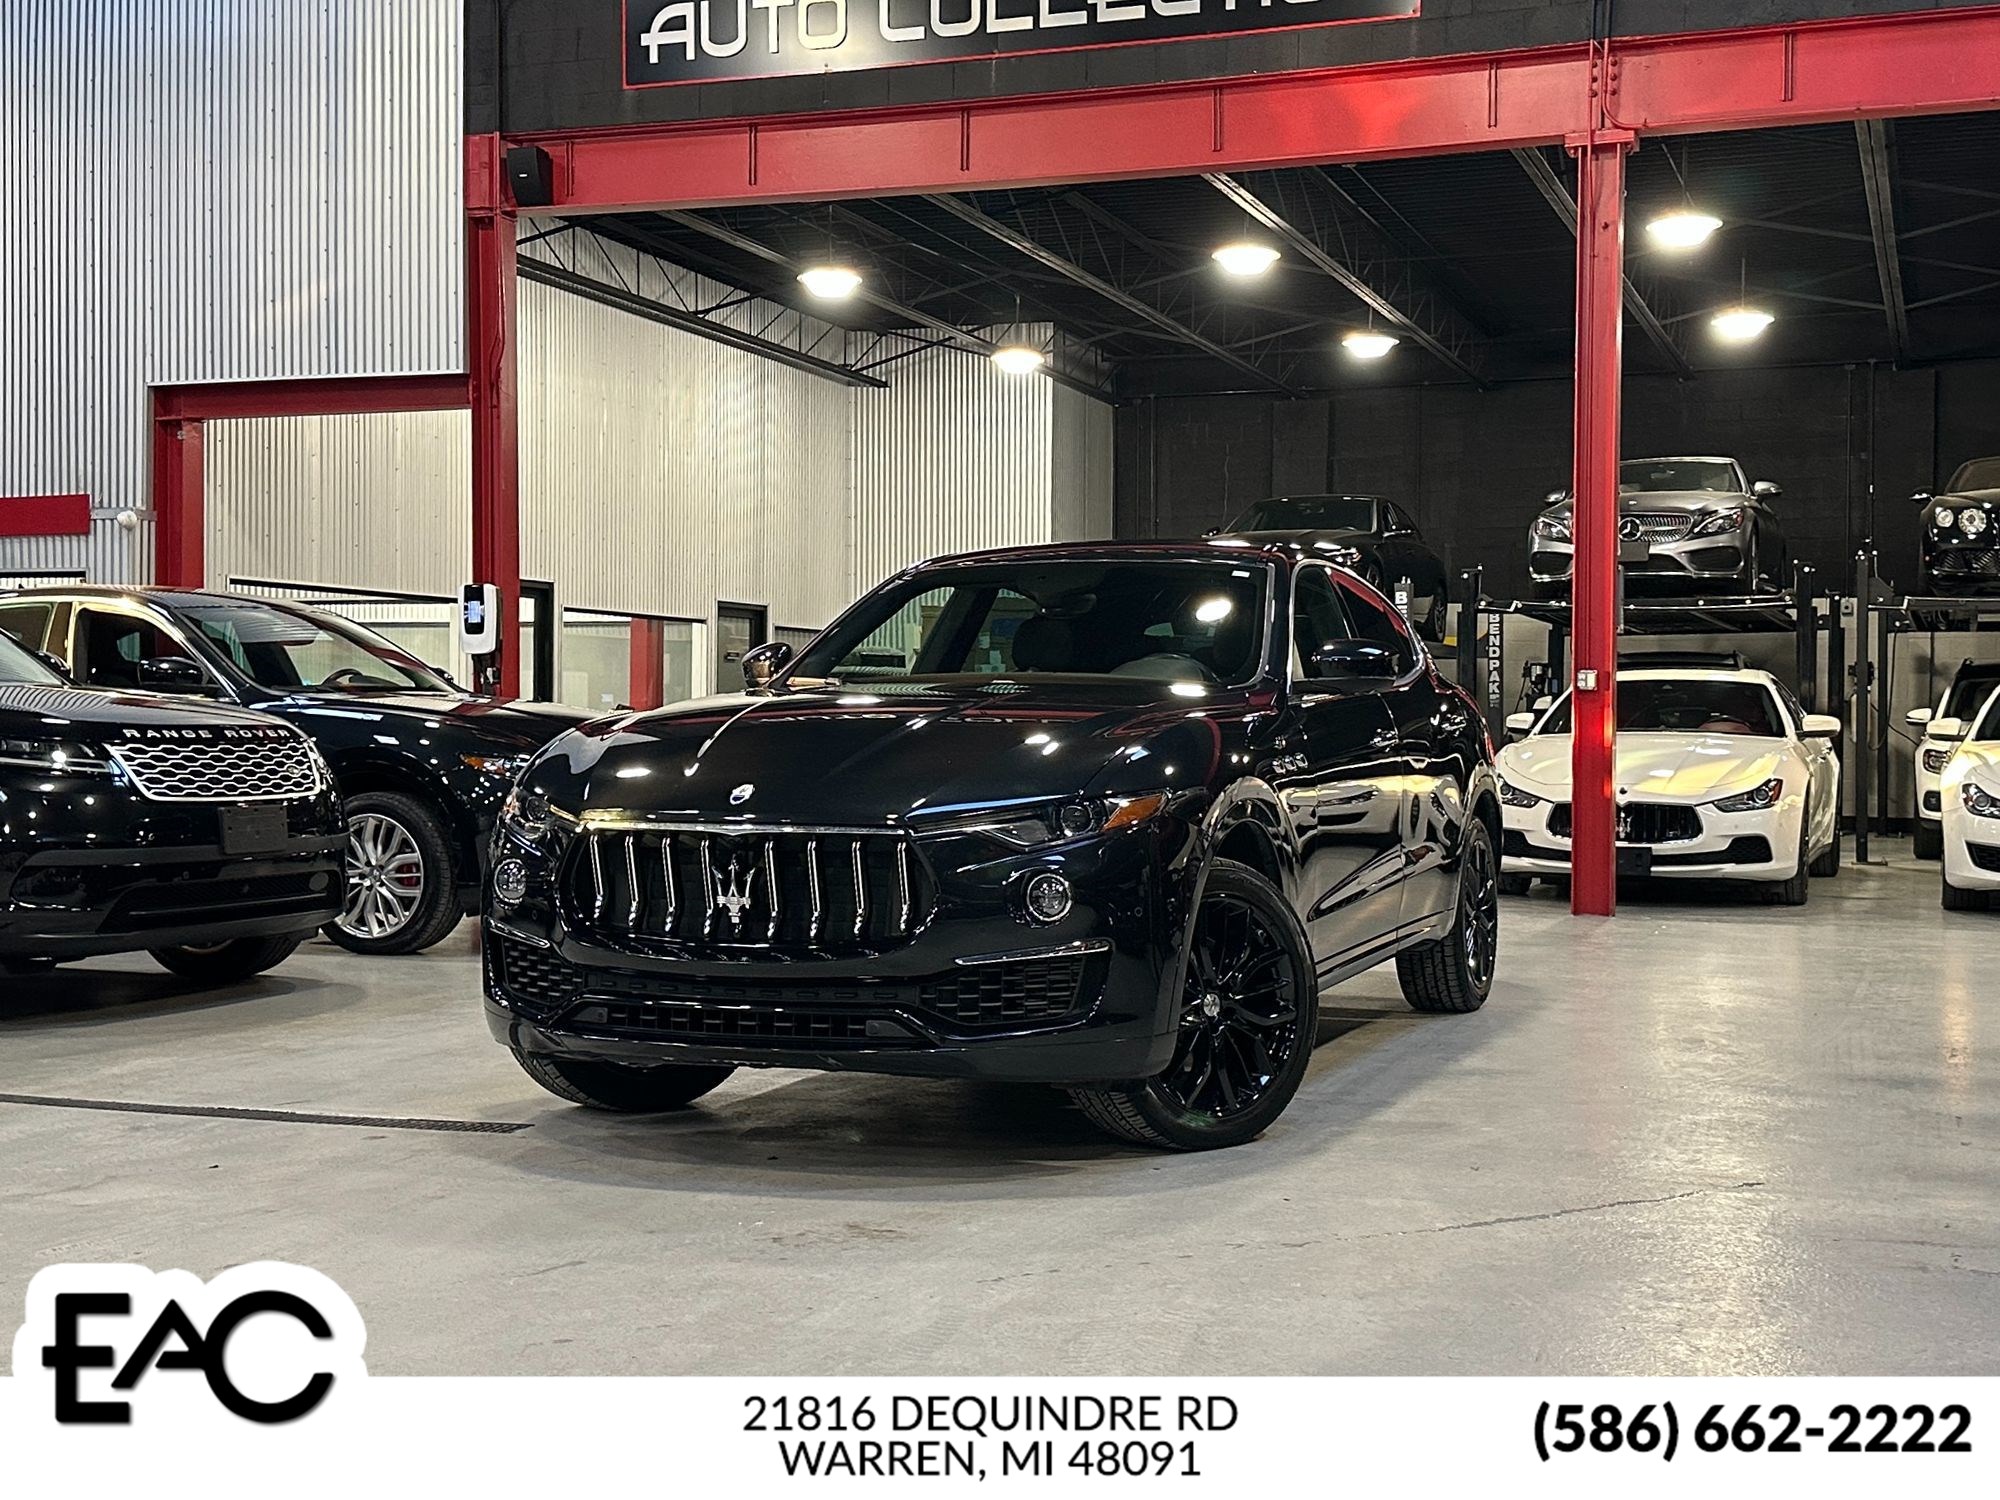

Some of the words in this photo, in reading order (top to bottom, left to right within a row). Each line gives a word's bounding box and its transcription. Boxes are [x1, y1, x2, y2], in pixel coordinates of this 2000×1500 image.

[640, 0, 847, 64] AUTO
[1488, 613, 1500, 694] BENDPAK
[123, 729, 212, 738] RANGE
[224, 729, 290, 738] ROVER
